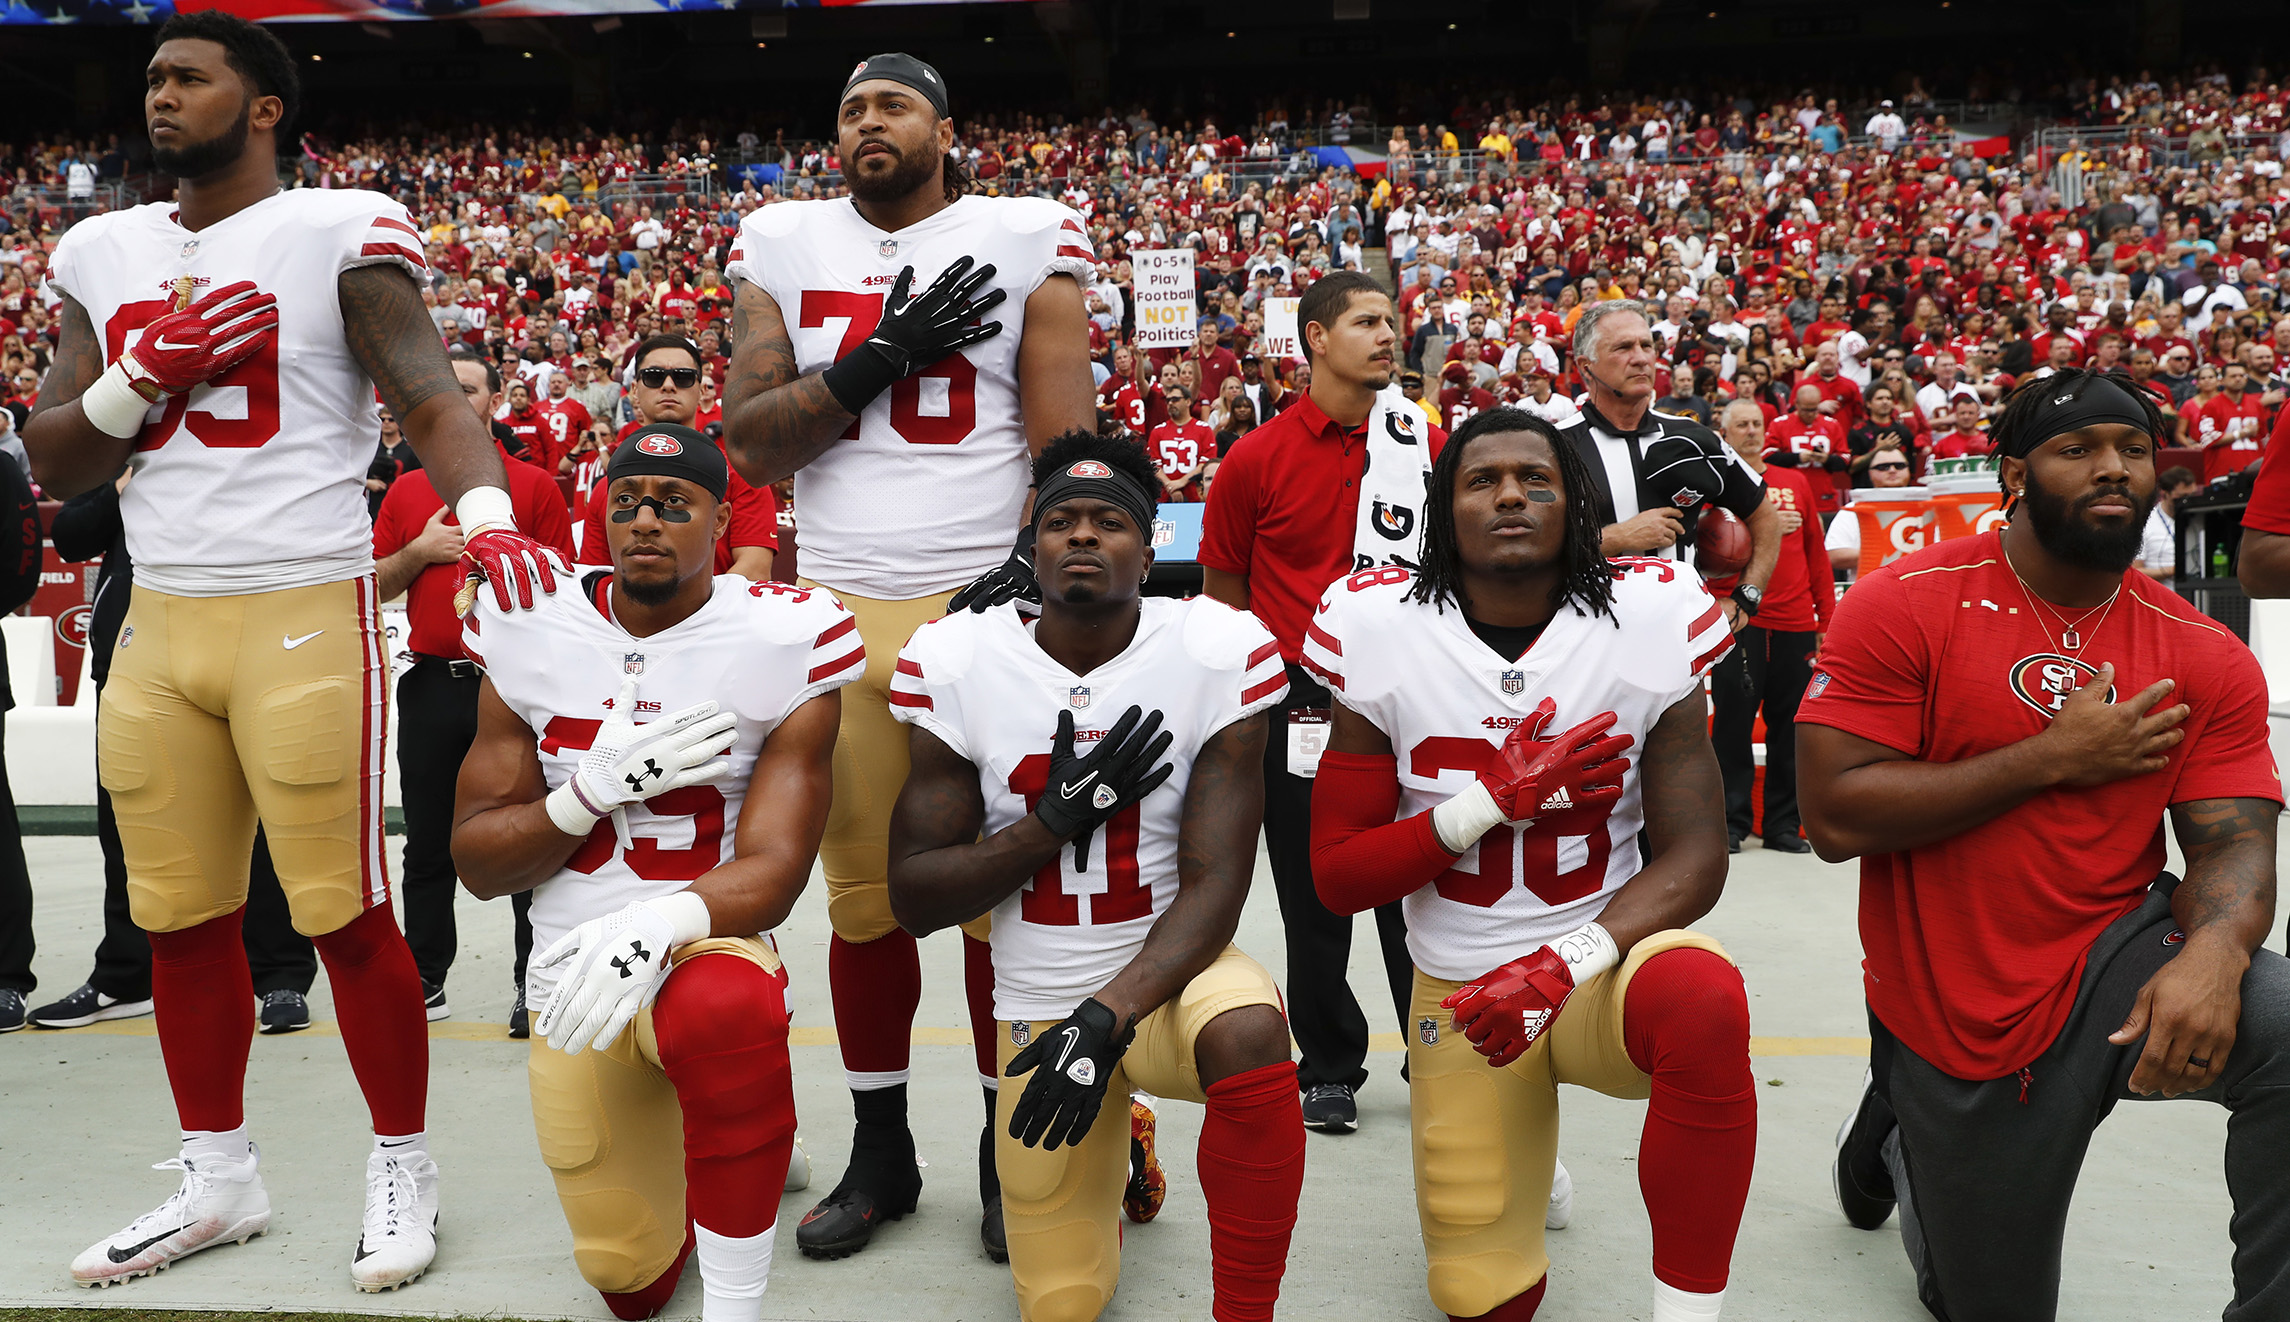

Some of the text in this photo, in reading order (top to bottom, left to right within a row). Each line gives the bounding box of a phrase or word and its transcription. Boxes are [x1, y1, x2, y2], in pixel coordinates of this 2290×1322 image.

[1218, 236, 1229, 253] 8
[1153, 256, 1178, 268] 0-5
[515, 276, 528, 297] 2
[1150, 274, 1179, 286] Play
[1137, 289, 1195, 302] Football
[1145, 306, 1189, 325] NOT
[1138, 329, 1196, 343] Politics
[1268, 338, 1294, 354] WE
[1159, 440, 1199, 474] 53
[1890, 516, 1925, 554] G
[41, 572, 75, 585] FIELD
[627, 662, 642, 673] NFL
[1504, 679, 1521, 692] NFL
[1072, 695, 1088, 708] NFL
[1300, 728, 1321, 755] 5
[1540, 799, 1574, 810] adidas
[1008, 753, 1154, 926] 11
[1526, 1007, 1553, 1042] adidas
[1014, 1031, 1028, 1042] NFL
[1422, 1029, 1436, 1041] NFL
